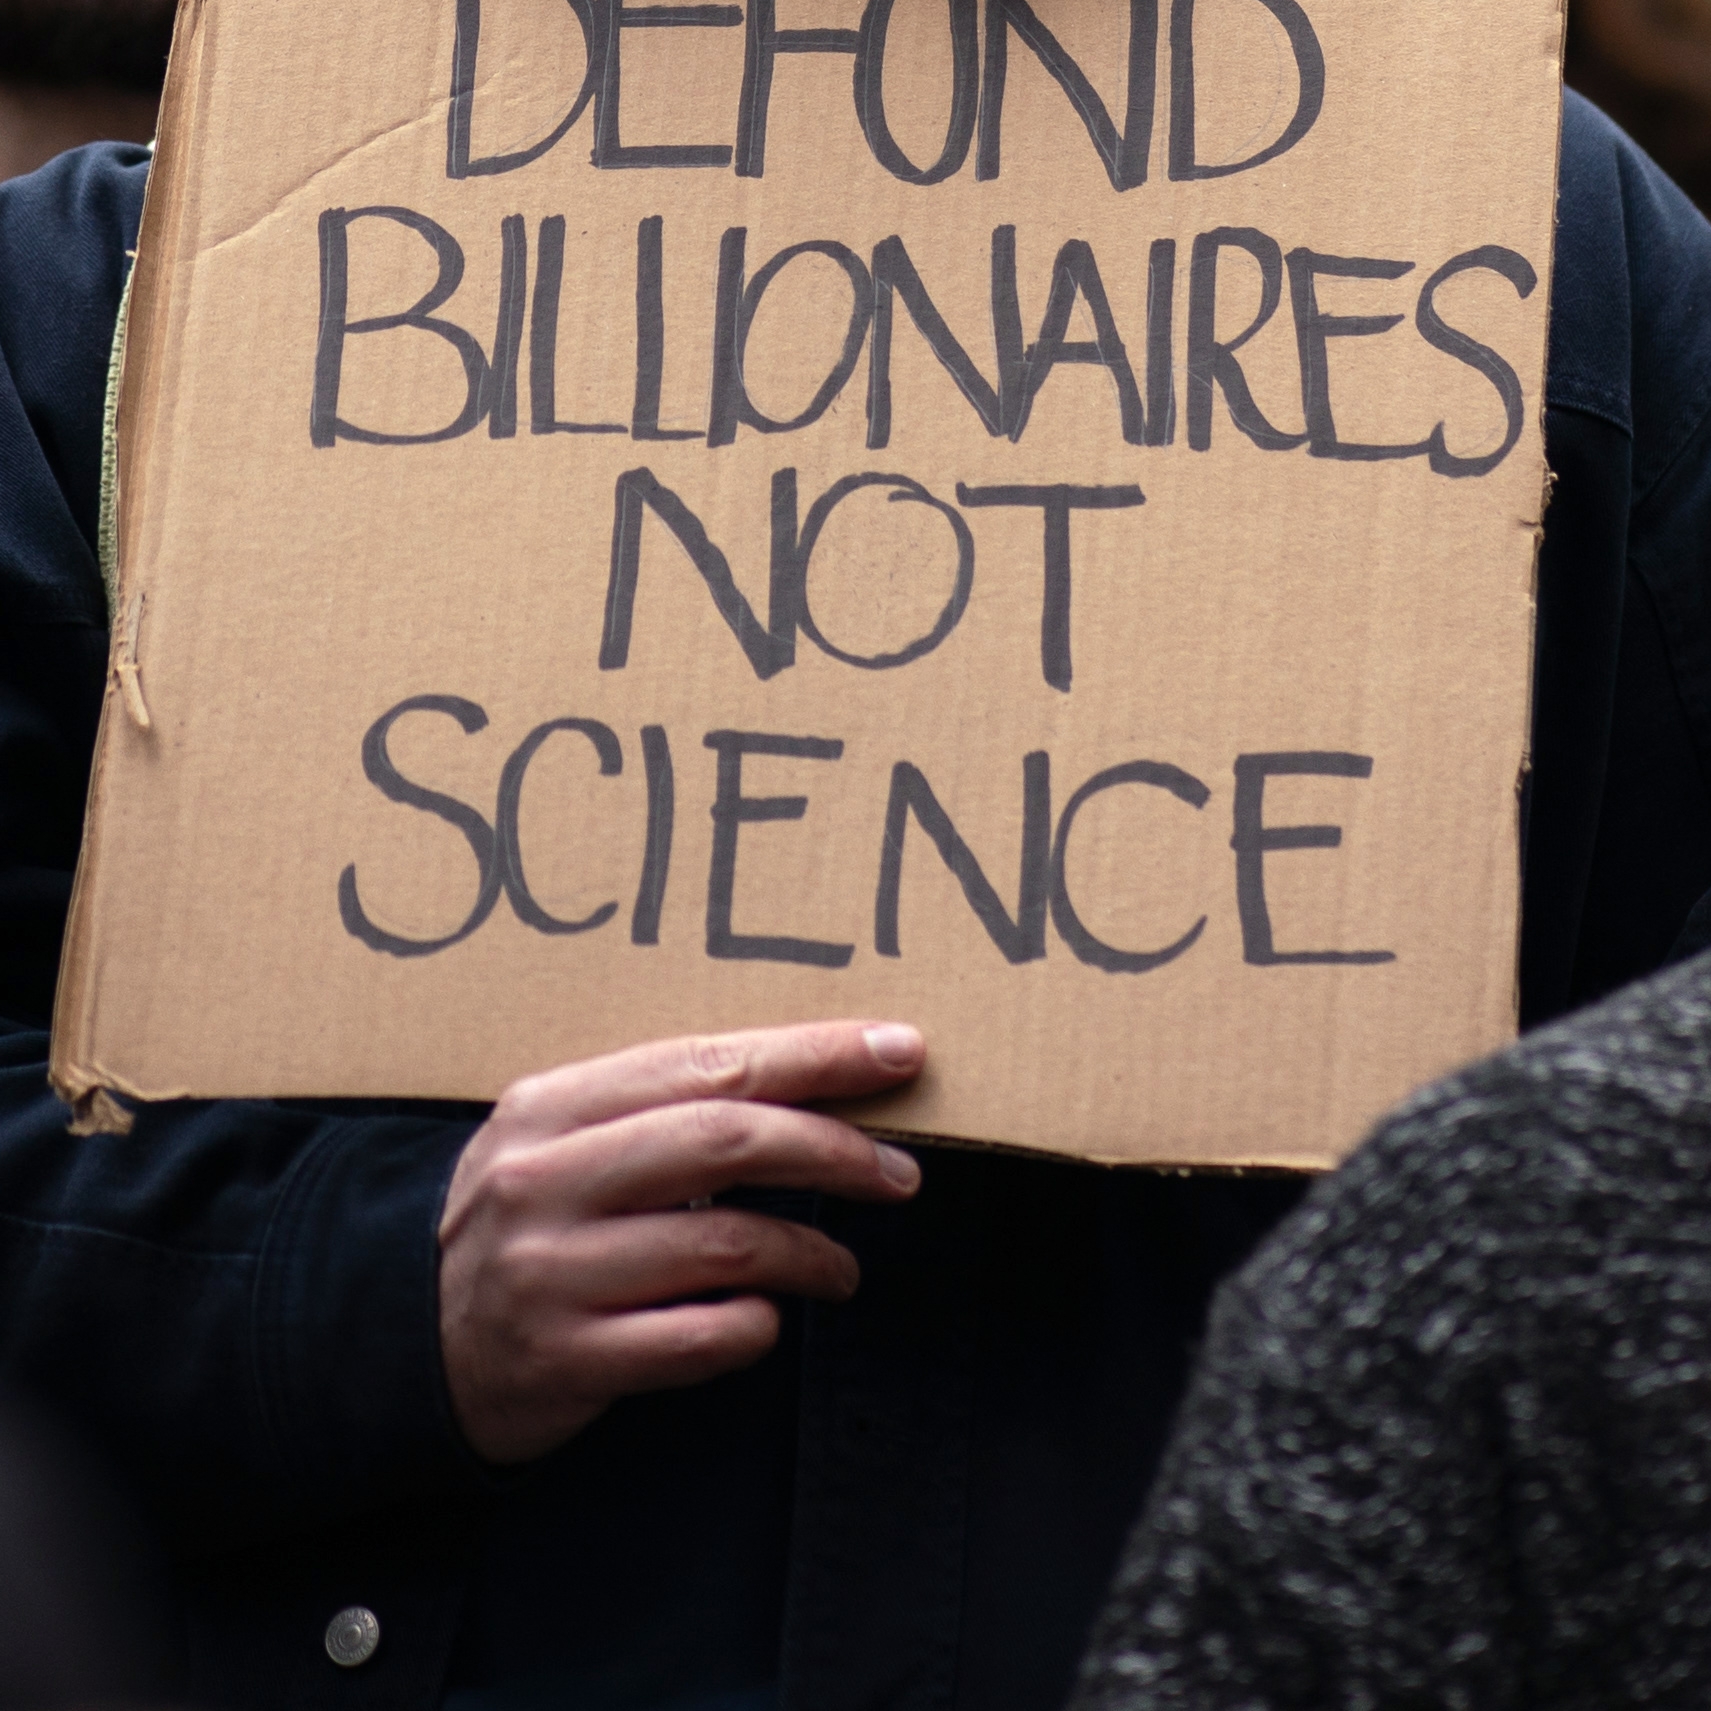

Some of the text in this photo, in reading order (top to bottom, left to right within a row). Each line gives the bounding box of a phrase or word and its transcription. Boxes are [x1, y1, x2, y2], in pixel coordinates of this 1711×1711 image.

[309, 204, 1539, 478] BILLIONAIRES
[597, 466, 1148, 693] NOT
[337, 694, 1398, 975] SCIENCE
